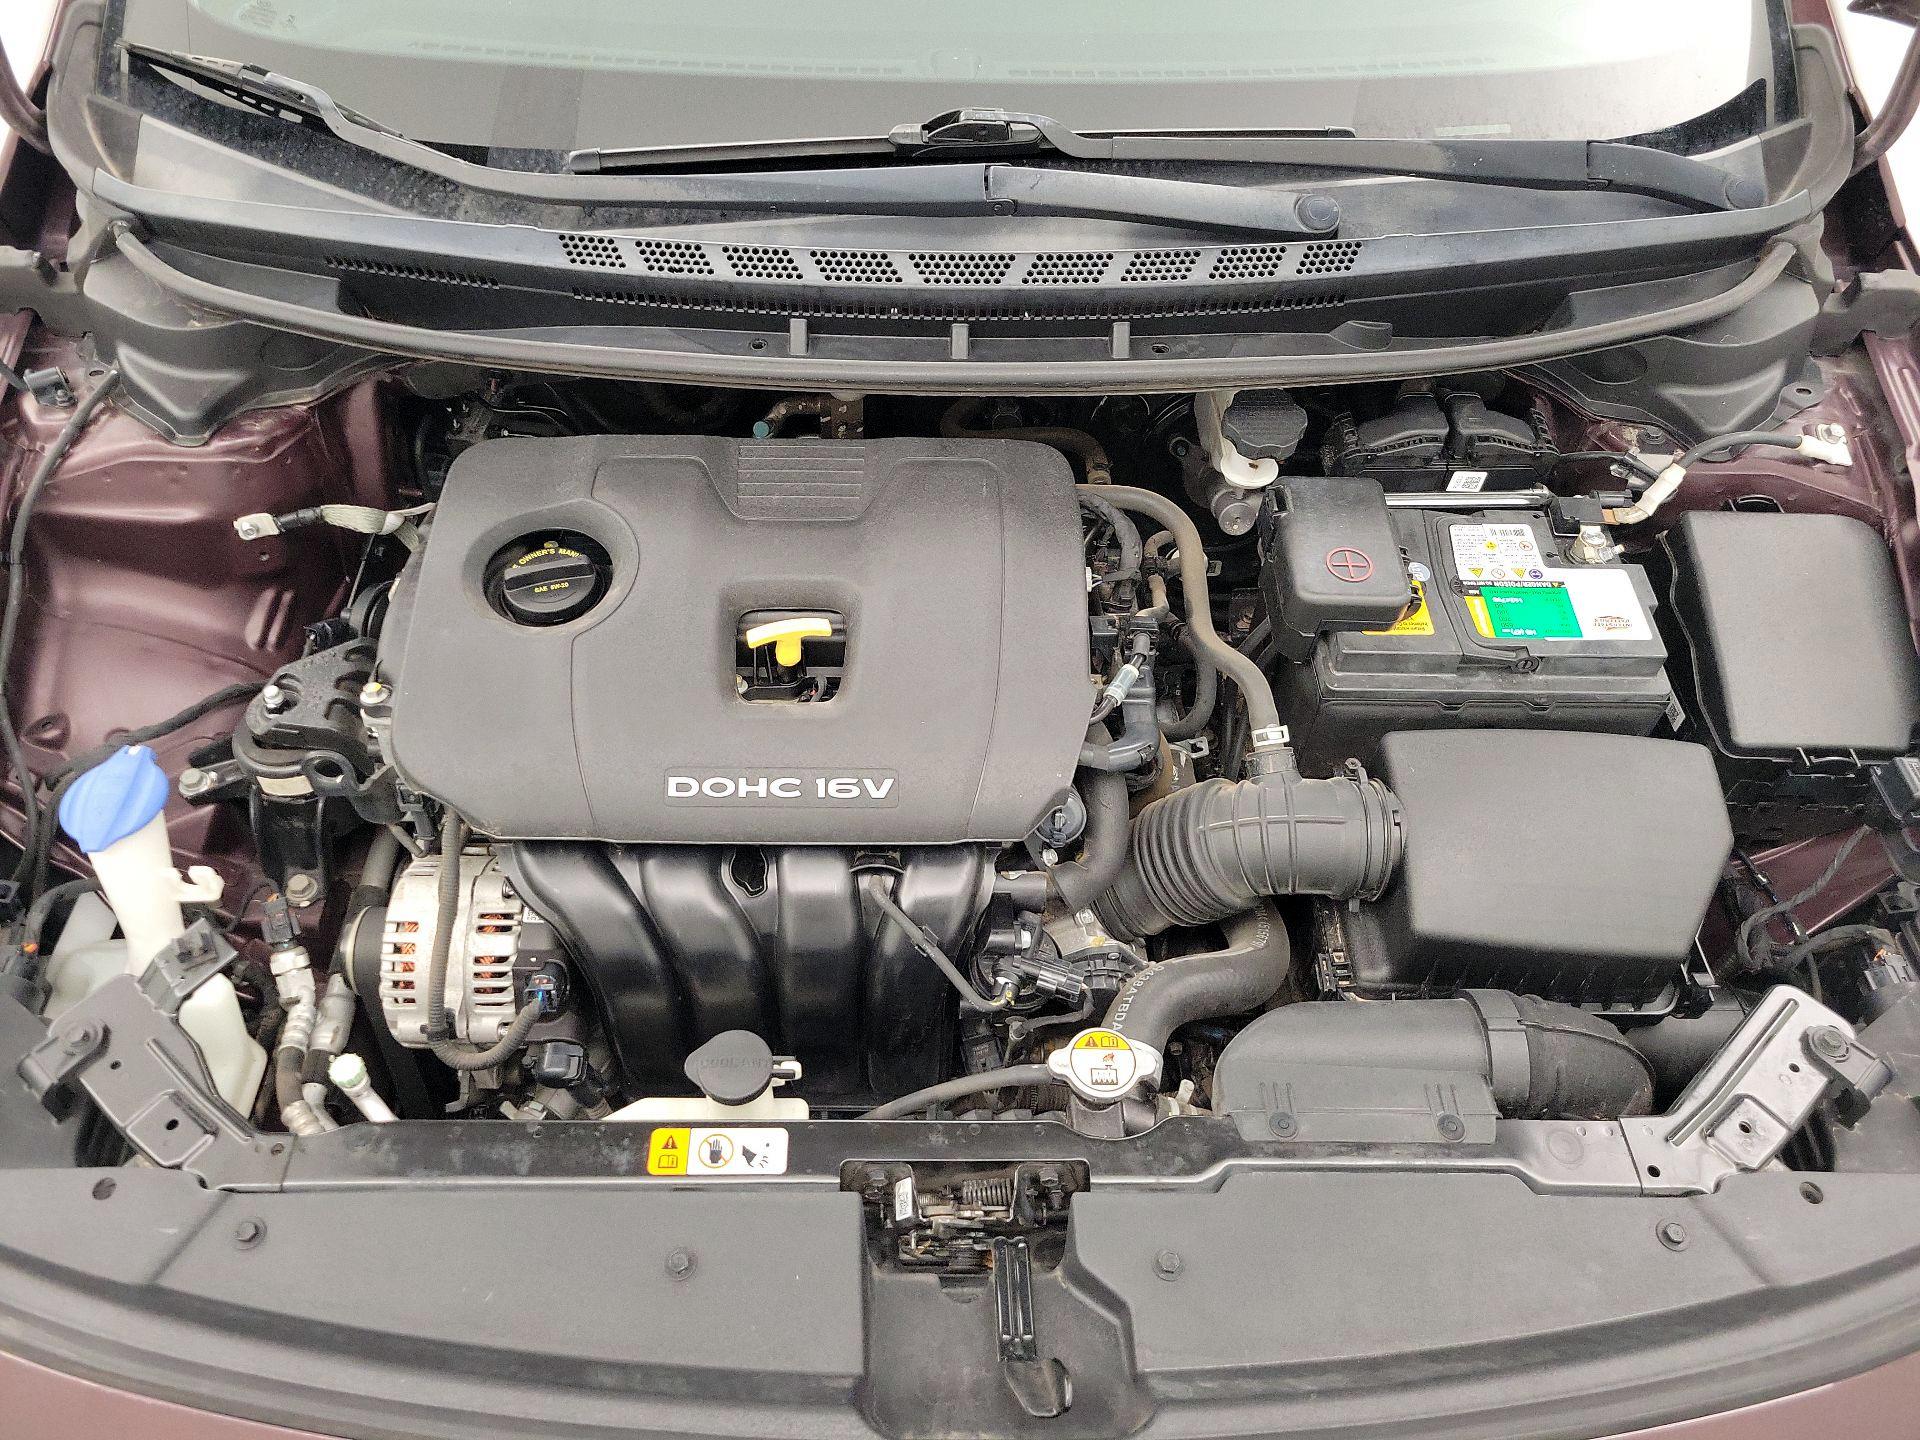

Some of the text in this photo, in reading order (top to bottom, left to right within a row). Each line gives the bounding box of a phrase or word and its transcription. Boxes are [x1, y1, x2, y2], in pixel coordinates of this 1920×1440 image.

[519, 549, 556, 565] OWNER'S
[667, 775, 895, 800] DOHC 16V
